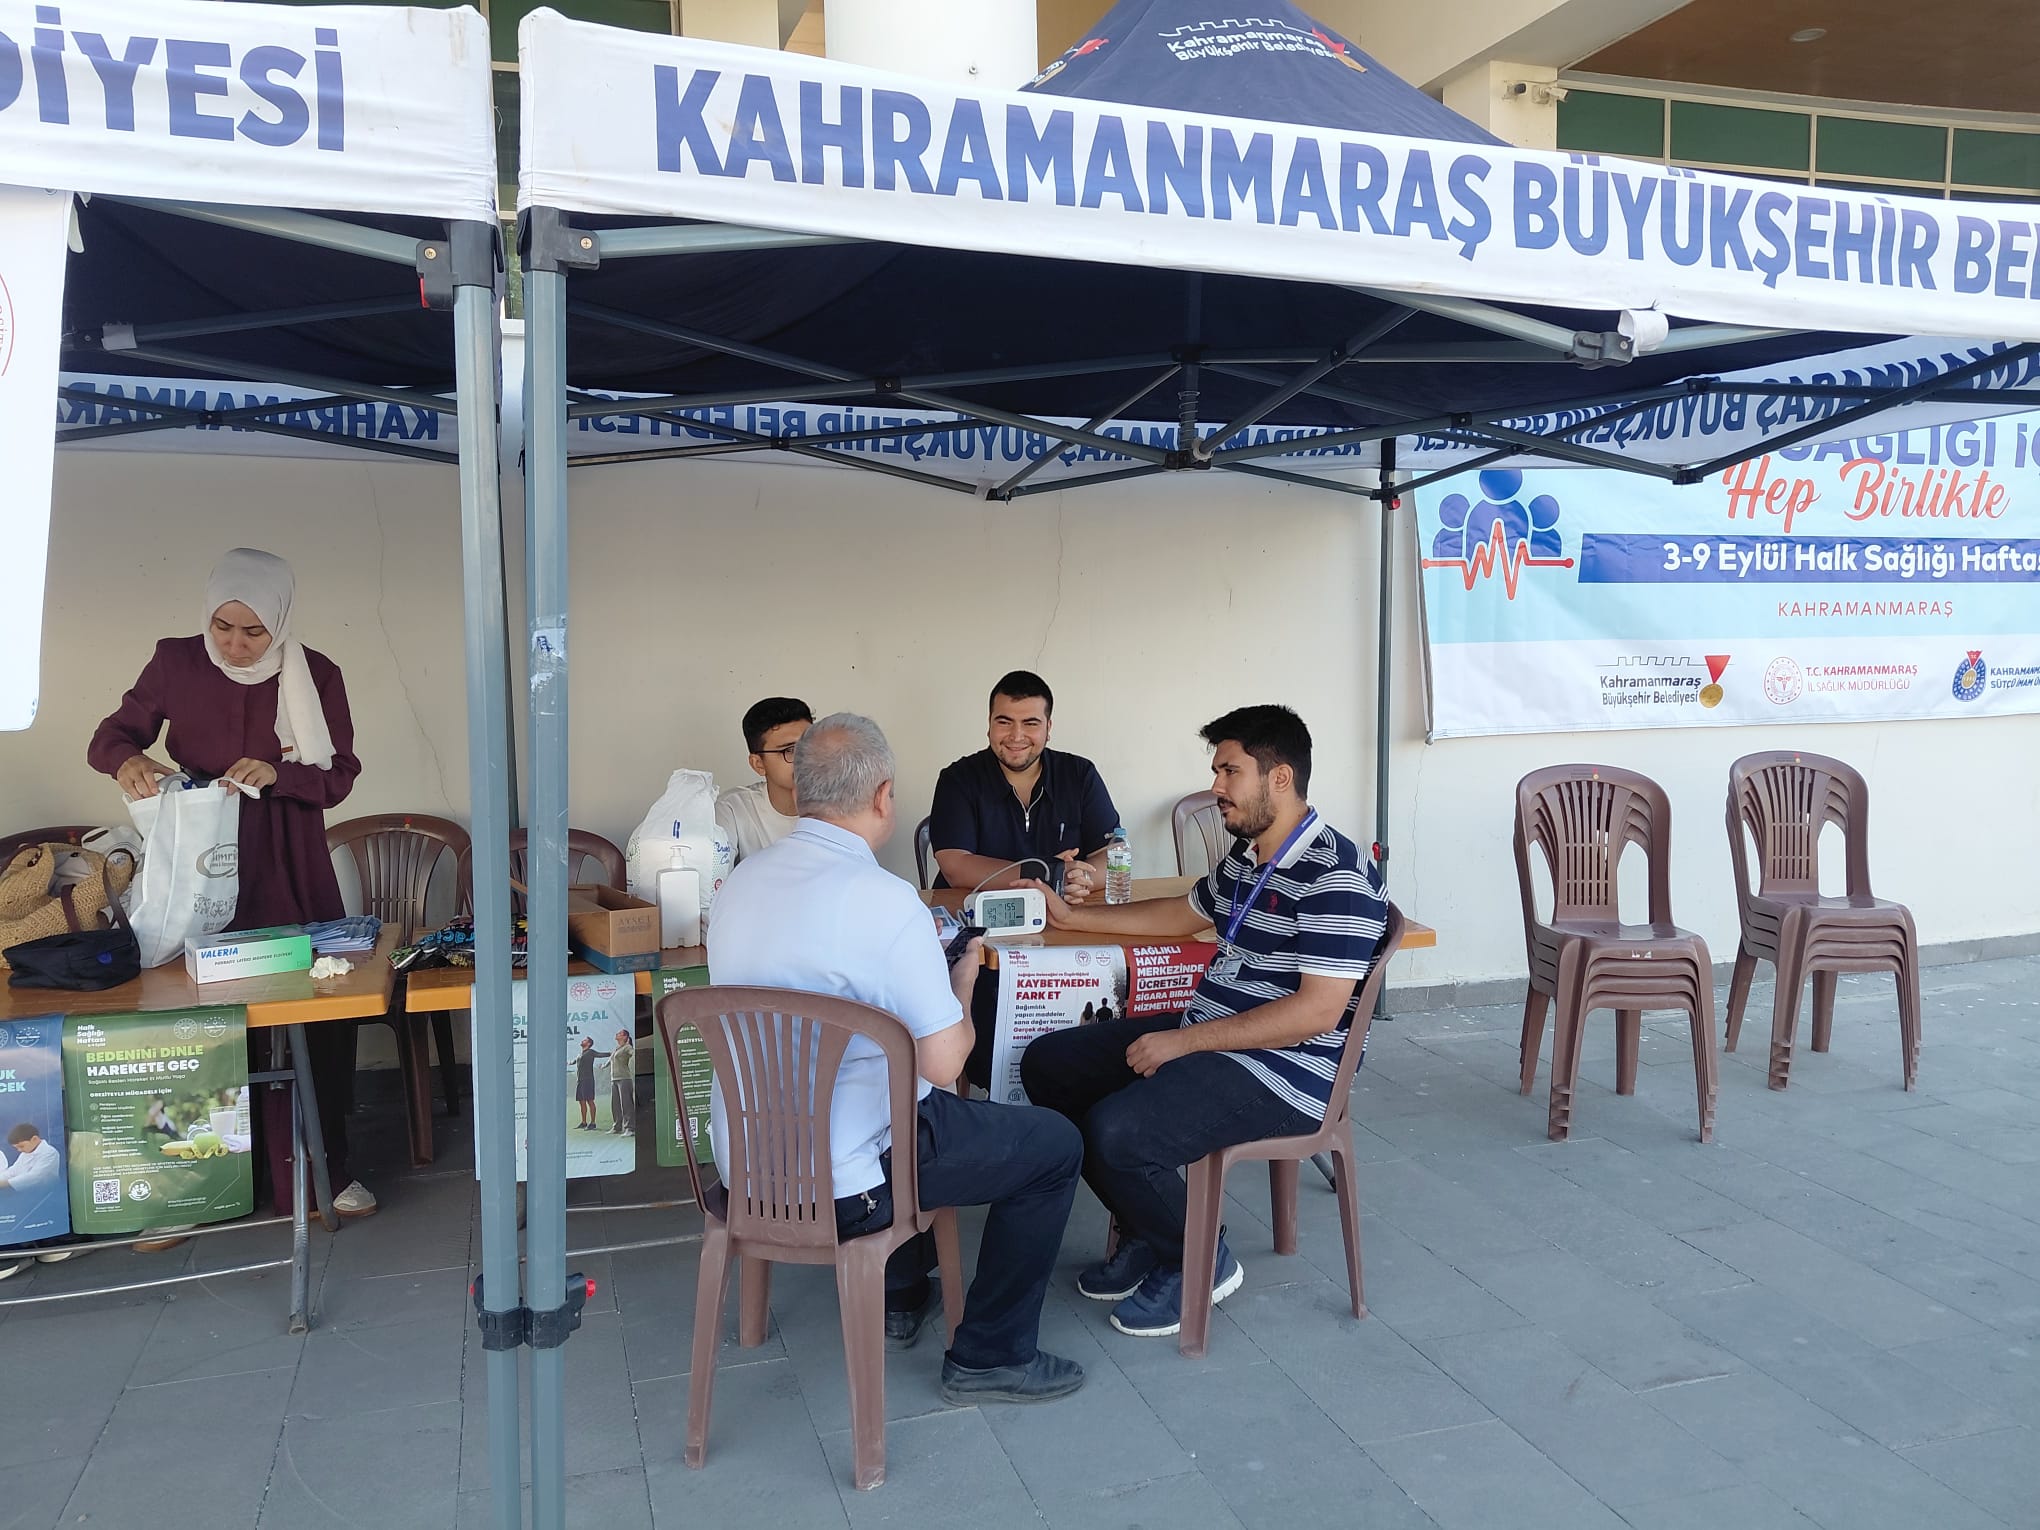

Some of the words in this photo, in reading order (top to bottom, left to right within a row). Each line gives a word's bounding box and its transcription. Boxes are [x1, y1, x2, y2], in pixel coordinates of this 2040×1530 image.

[1175, 40, 1260, 61] Büyükşehir
[653, 64, 1493, 261] KAHRAMANMARAŞ
[1513, 153, 1941, 289] BÜYÜKŞEHİR
[1954, 215, 2040, 300] BE
[2014, 423, 2040, 477] İ
[1721, 454, 1822, 534] Hep
[1839, 456, 2011, 521] Birlikte
[1663, 543, 1711, 571] 3-9
[1718, 543, 1787, 578] Eylül
[1795, 544, 1858, 571] Halk
[1864, 545, 1955, 579] Sağlığı
[1778, 601, 1954, 618] KAHRAMANMARAŞ
[1806, 666, 1822, 677] T.C.
[1823, 665, 1918, 677] KAHRAMANMARAŞ
[1600, 675, 1702, 690] Kahramanmaraş
[1816, 679, 1845, 692] SAĞLIK
[1848, 677, 1911, 691] MÜDÜRLÜĞÜ
[1602, 691, 1651, 708] Büyükşehir
[1653, 689, 1698, 706] Belediyesi
[1004, 903, 1016, 911] 155
[200, 946, 239, 959] VALERIA
[1133, 945, 1181, 956] SAĞLIKLI
[1136, 955, 1170, 967] HAYAT
[1137, 962, 1205, 977] MERKEZİNDE
[1016, 978, 1099, 988] KAYBETMEDEN
[1139, 977, 1189, 990] ÜCRETSİZ
[1016, 991, 1045, 1000] FARK
[1048, 991, 1061, 1000] ET
[1135, 991, 1168, 1001] SİGARA
[1134, 1000, 1171, 1012] HİZMETİ
[591, 1010, 609, 1020] AL
[566, 1025, 580, 1035] AL
[86, 1047, 157, 1063] BEDENİNİ
[160, 1045, 204, 1058] DİNLE
[87, 1061, 165, 1077] HAREKETE
[167, 1058, 200, 1072] GEÇ
[158, 1087, 172, 1095] İÇİN
